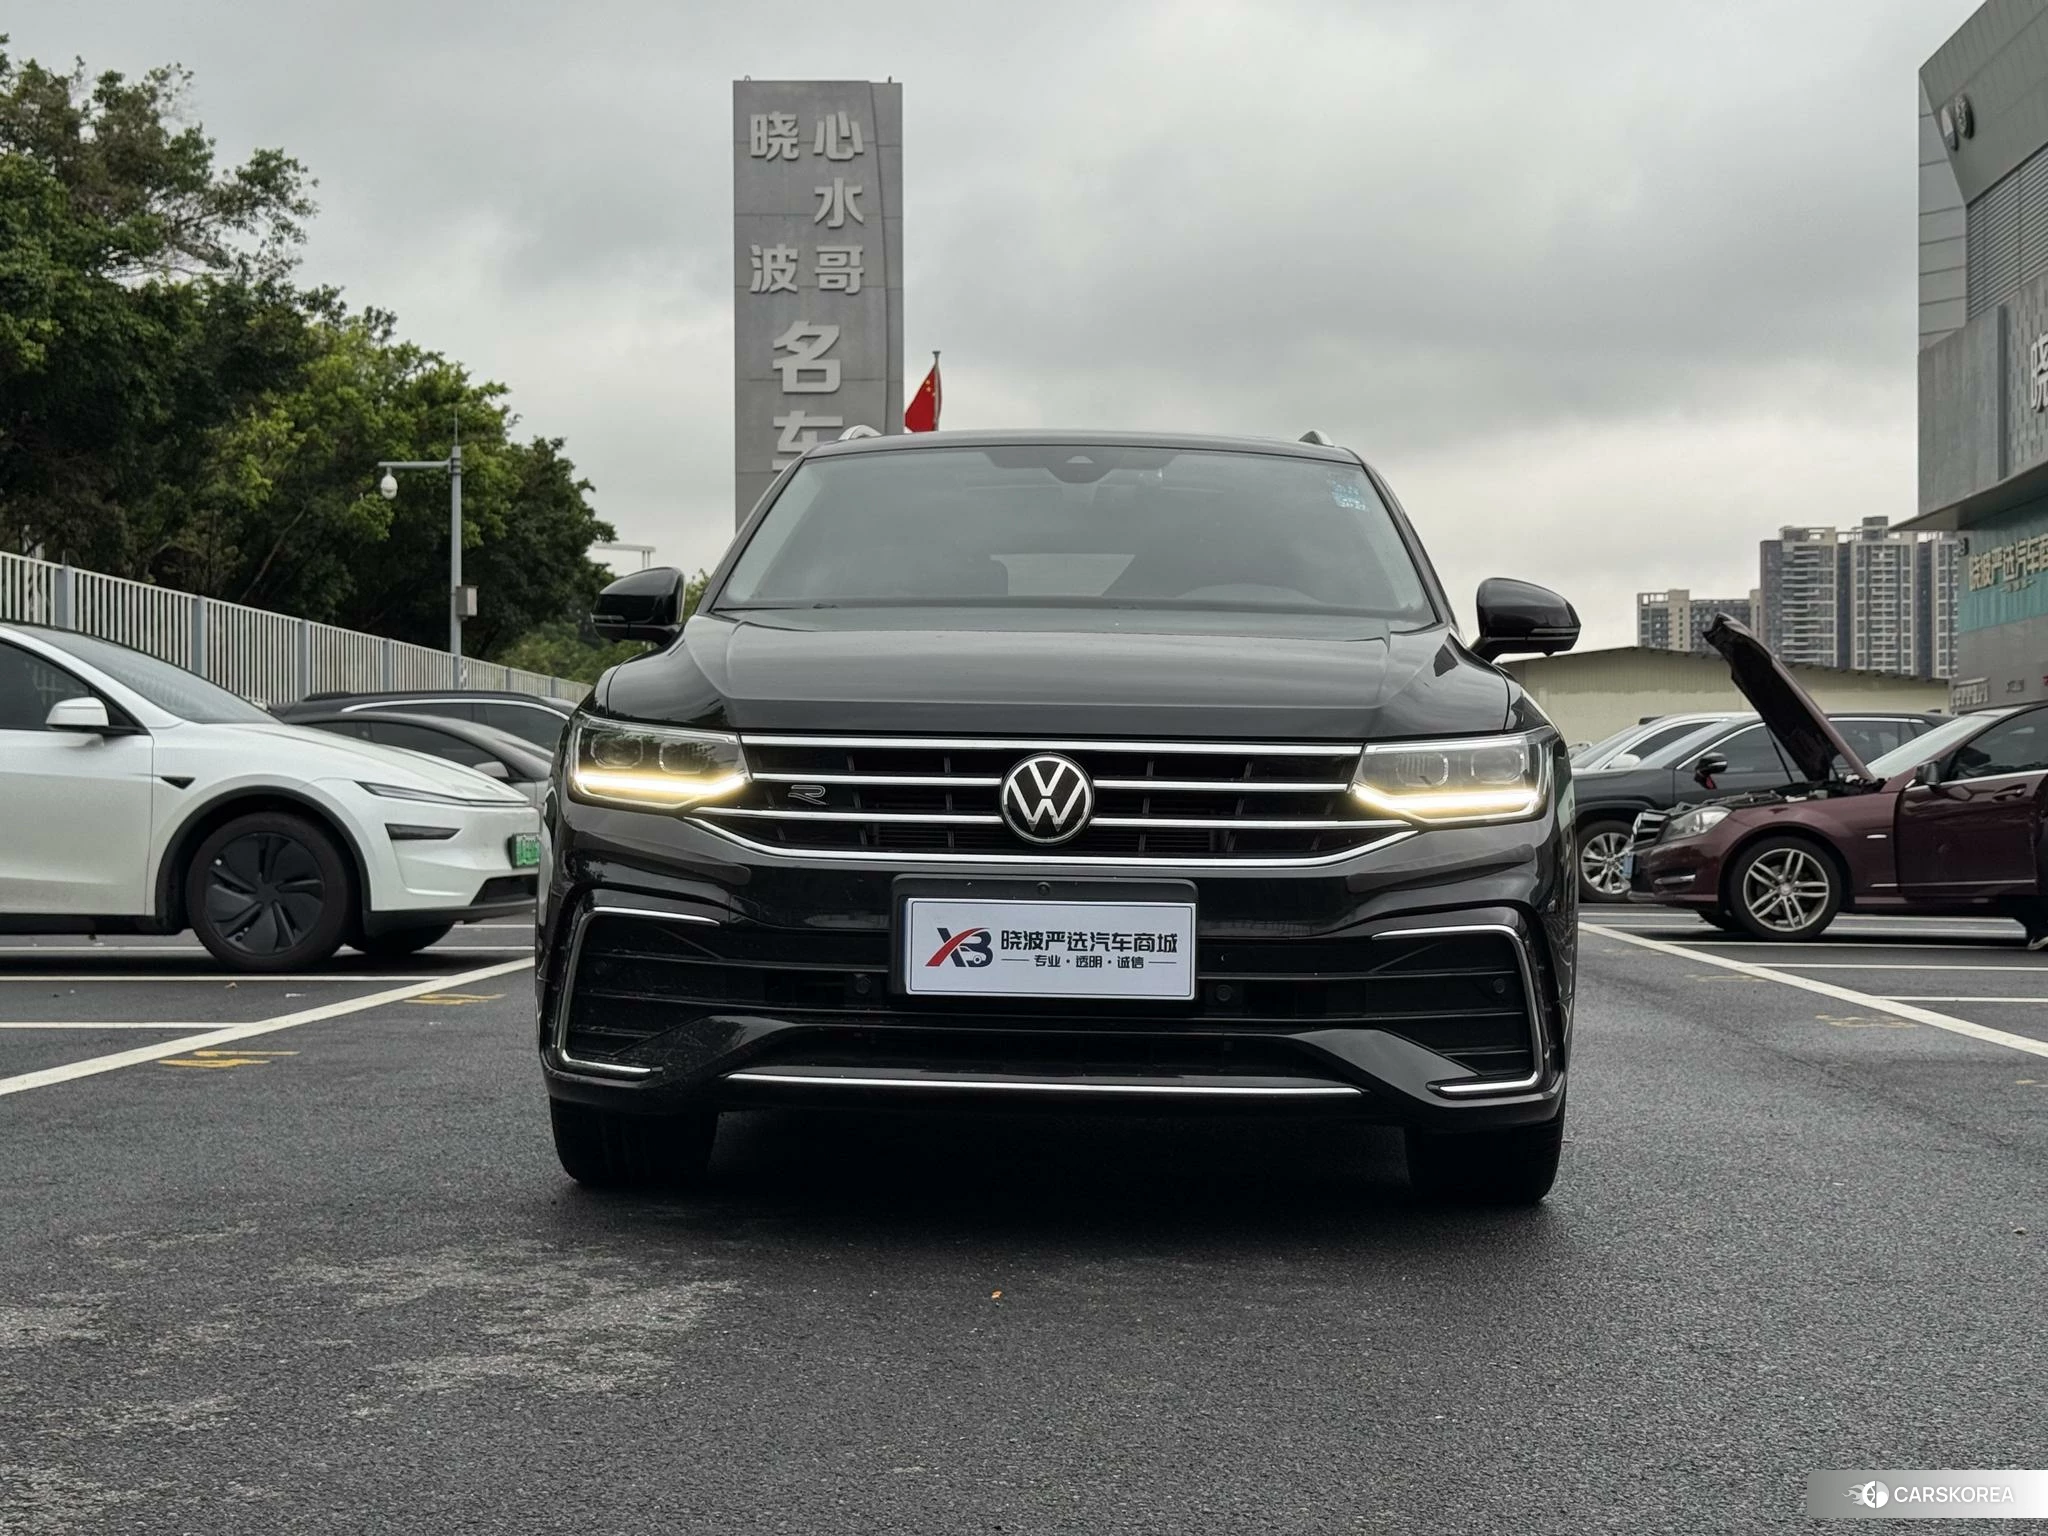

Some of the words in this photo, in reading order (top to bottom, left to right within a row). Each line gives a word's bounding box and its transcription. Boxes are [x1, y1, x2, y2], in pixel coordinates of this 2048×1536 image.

[749, 111, 800, 294] 晓波
[812, 111, 864, 294] 心水哥
[771, 320, 844, 473] 名车
[787, 784, 828, 806] R
[1000, 930, 1178, 953] 晓波严选汽车商城
